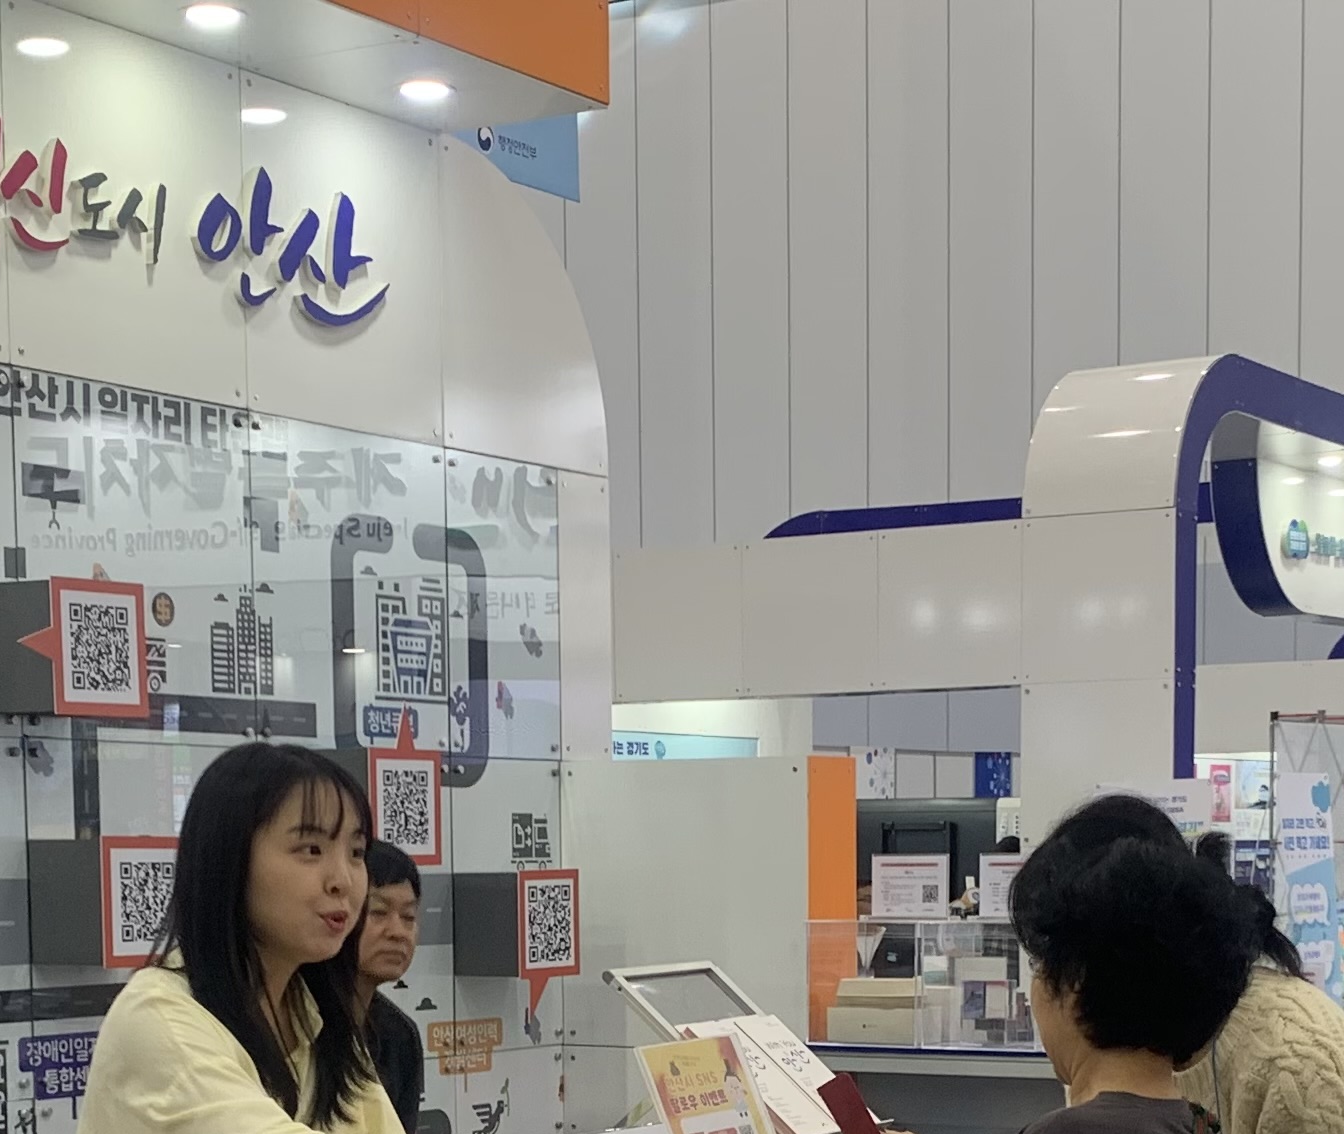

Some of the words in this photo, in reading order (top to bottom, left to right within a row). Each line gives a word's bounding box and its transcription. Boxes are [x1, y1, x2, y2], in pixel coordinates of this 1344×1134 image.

[197, 166, 390, 326] 안산
[97, 385, 194, 446] 일자리
[627, 741, 649, 755] 경기도
[695, 1071, 719, 1087] SNS
